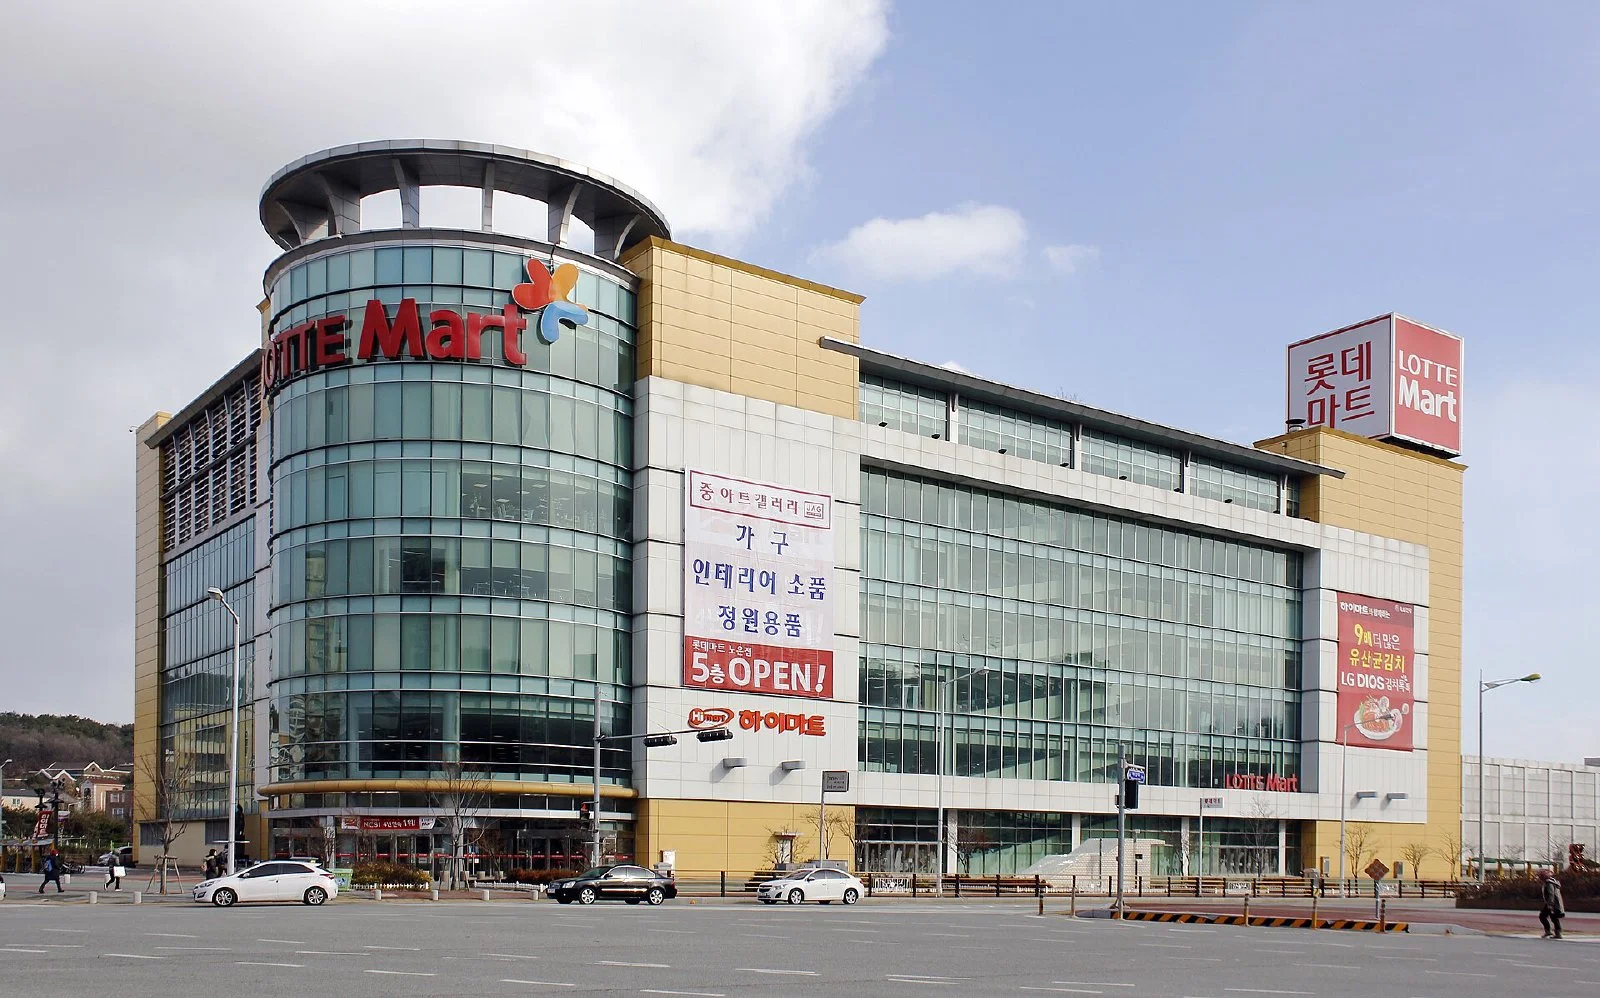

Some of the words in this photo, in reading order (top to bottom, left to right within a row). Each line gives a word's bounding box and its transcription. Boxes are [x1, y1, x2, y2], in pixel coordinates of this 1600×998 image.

[357, 298, 527, 366] Mart
[1305, 341, 1371, 396] 롯데
[1399, 350, 1458, 387] LOTTE
[1307, 385, 1375, 429] 마트
[1399, 375, 1457, 423] Mart
[692, 558, 776, 595] 인테리어
[787, 573, 826, 601] 소품
[718, 605, 802, 638] 정원용품
[692, 640, 726, 653] 롯데마트
[728, 644, 752, 657] 노은점
[692, 651, 726, 684] 5층
[728, 657, 827, 693] OPEN!
[1341, 671, 1355, 687] LG
[1356, 673, 1385, 690] DIOS
[739, 709, 827, 737] 하이마트
[1226, 773, 1264, 791] LOTTE
[1266, 772, 1298, 792] Mart
